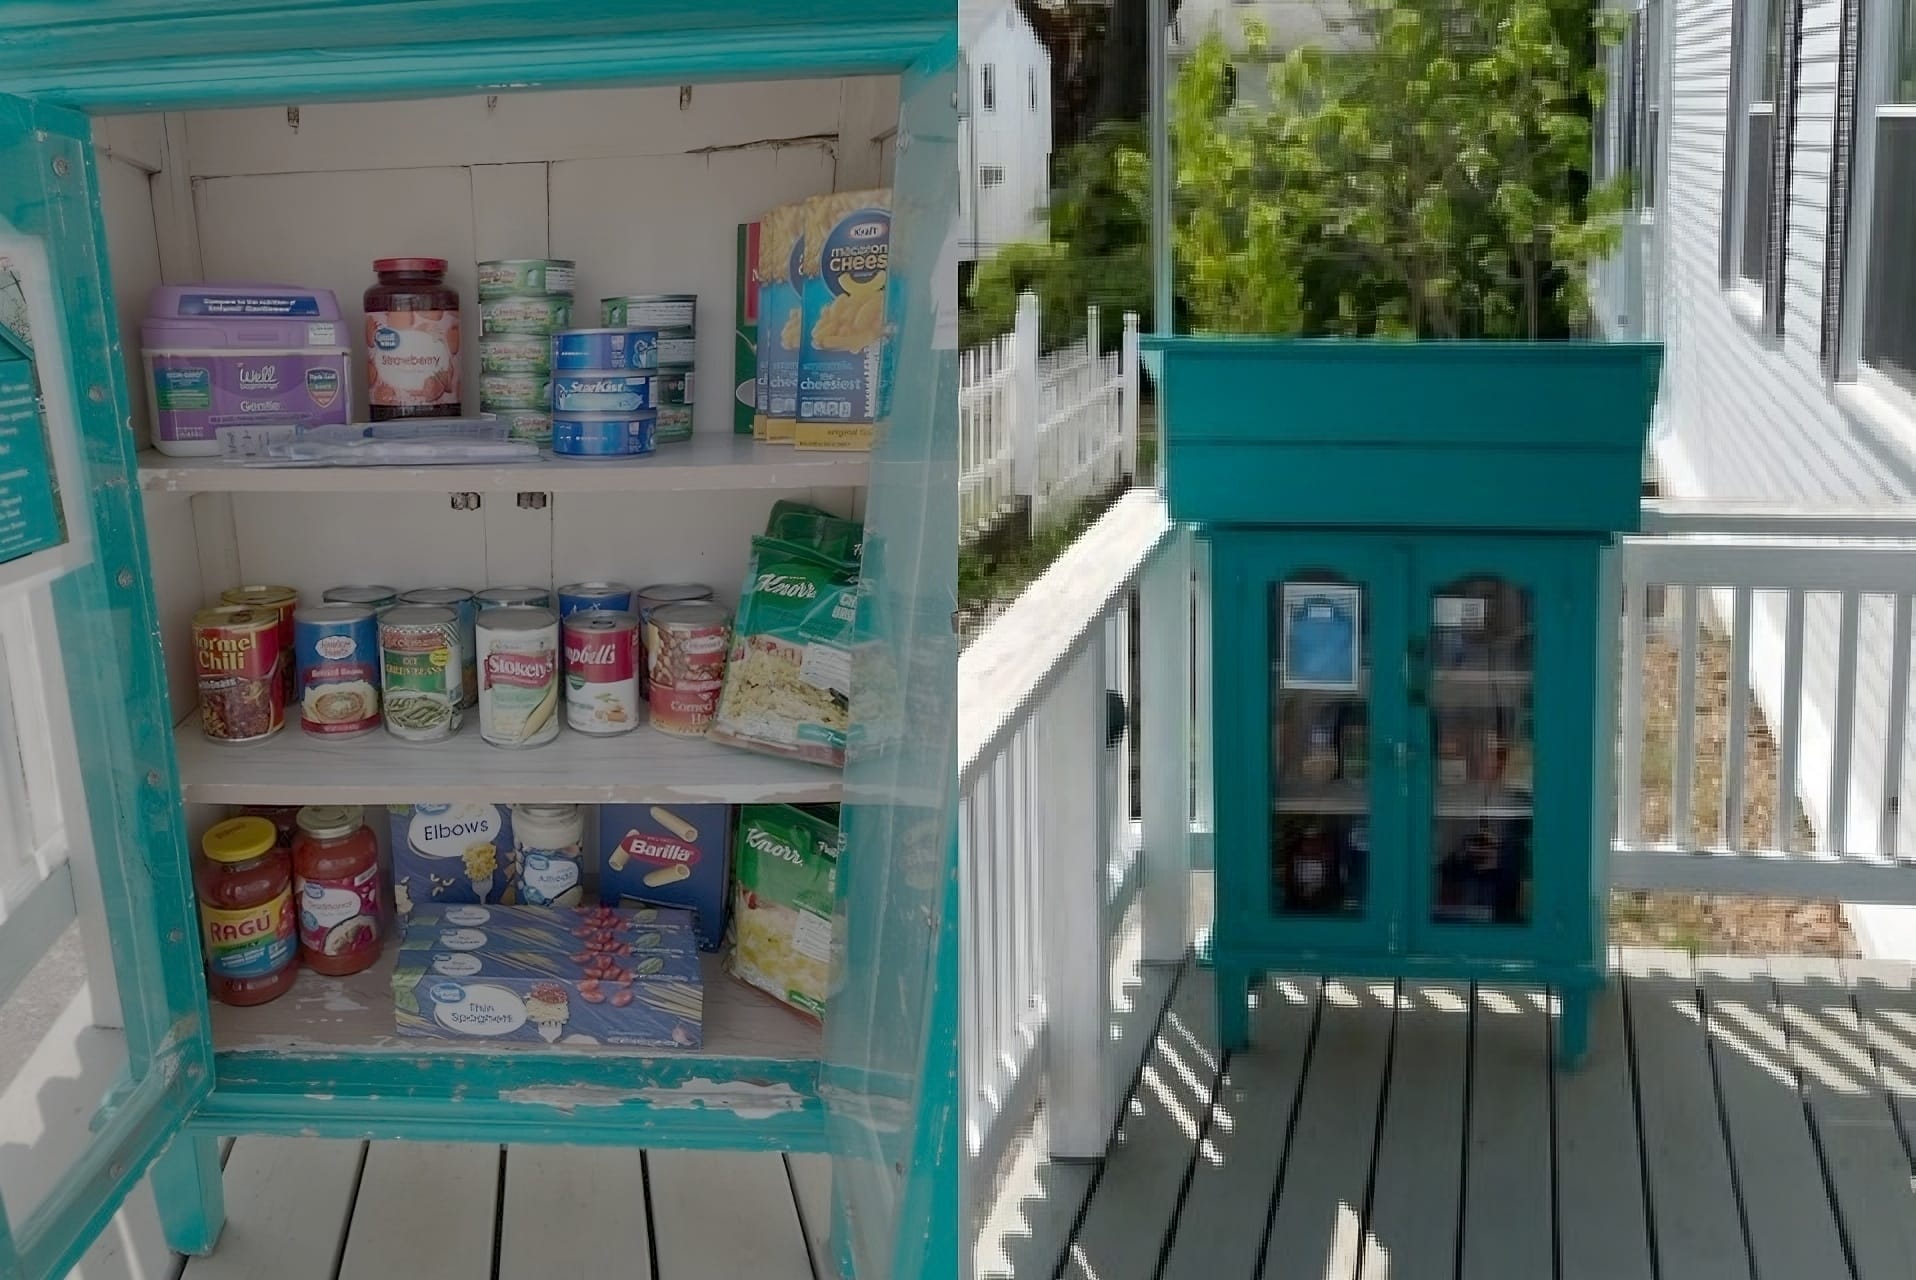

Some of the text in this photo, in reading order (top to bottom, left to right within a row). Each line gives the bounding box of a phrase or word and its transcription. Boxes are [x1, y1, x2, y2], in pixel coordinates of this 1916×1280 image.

[829, 253, 888, 272] CHees
[381, 354, 441, 366] Strawberry
[756, 573, 818, 599] Knorr
[198, 651, 245, 670] Chili
[424, 820, 489, 841] Elbows
[629, 838, 691, 862] Barilla
[745, 827, 806, 867] Knorr
